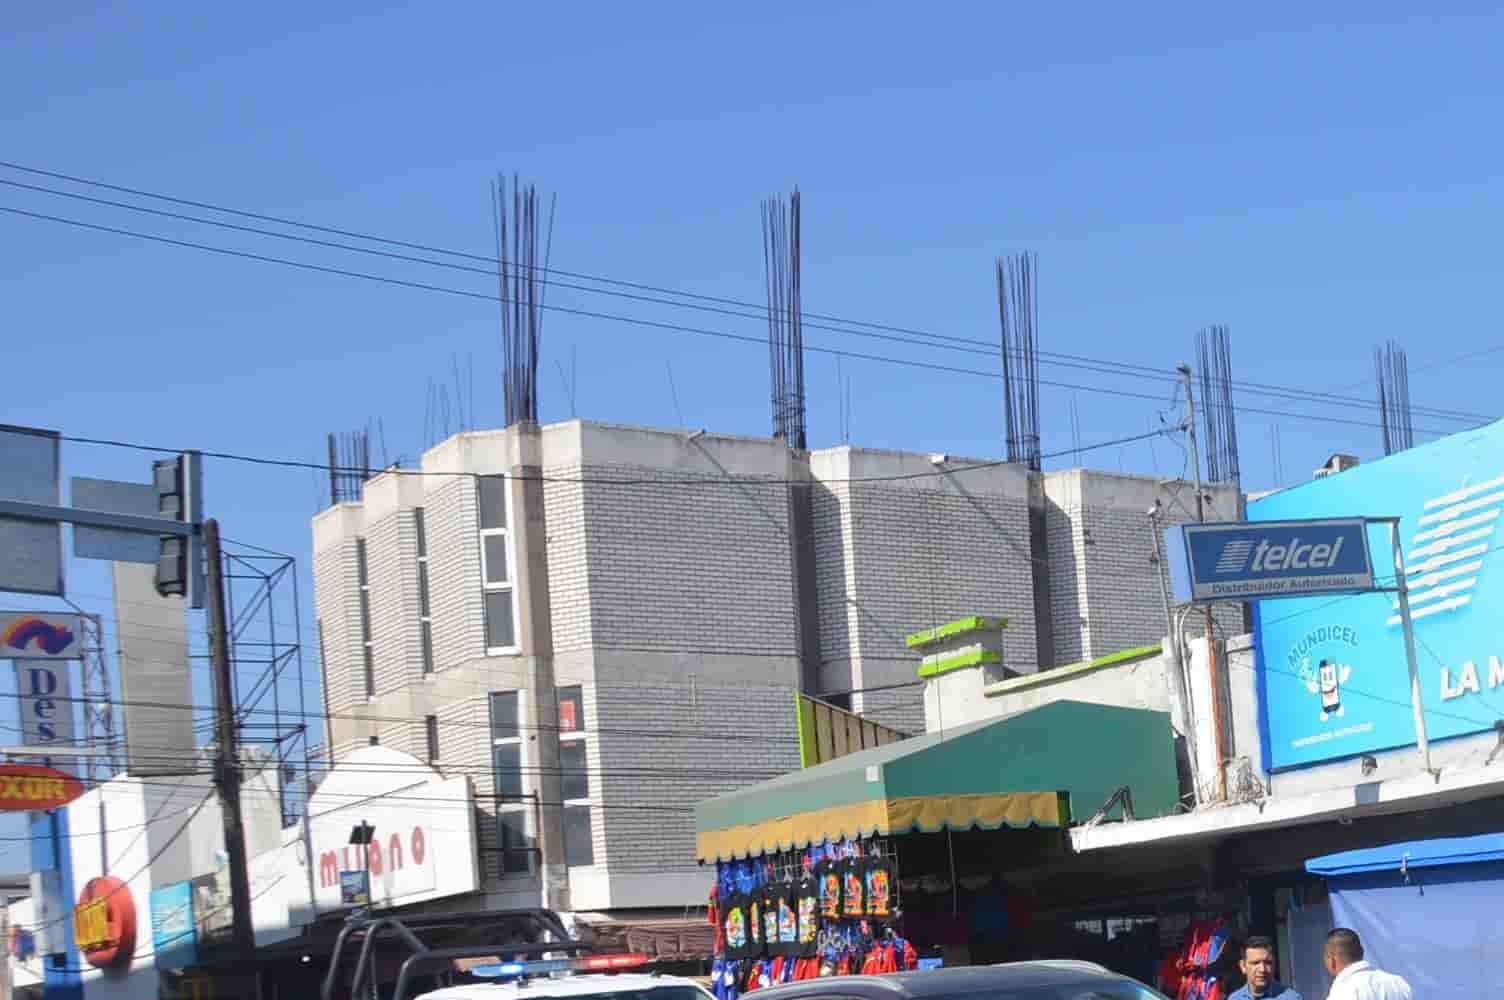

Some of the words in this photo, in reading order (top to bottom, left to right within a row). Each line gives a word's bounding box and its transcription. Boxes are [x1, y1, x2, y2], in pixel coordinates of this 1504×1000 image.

[1250, 535, 1345, 573] telcel
[1287, 624, 1360, 668] MUNDICEL
[1440, 660, 1479, 701] LA
